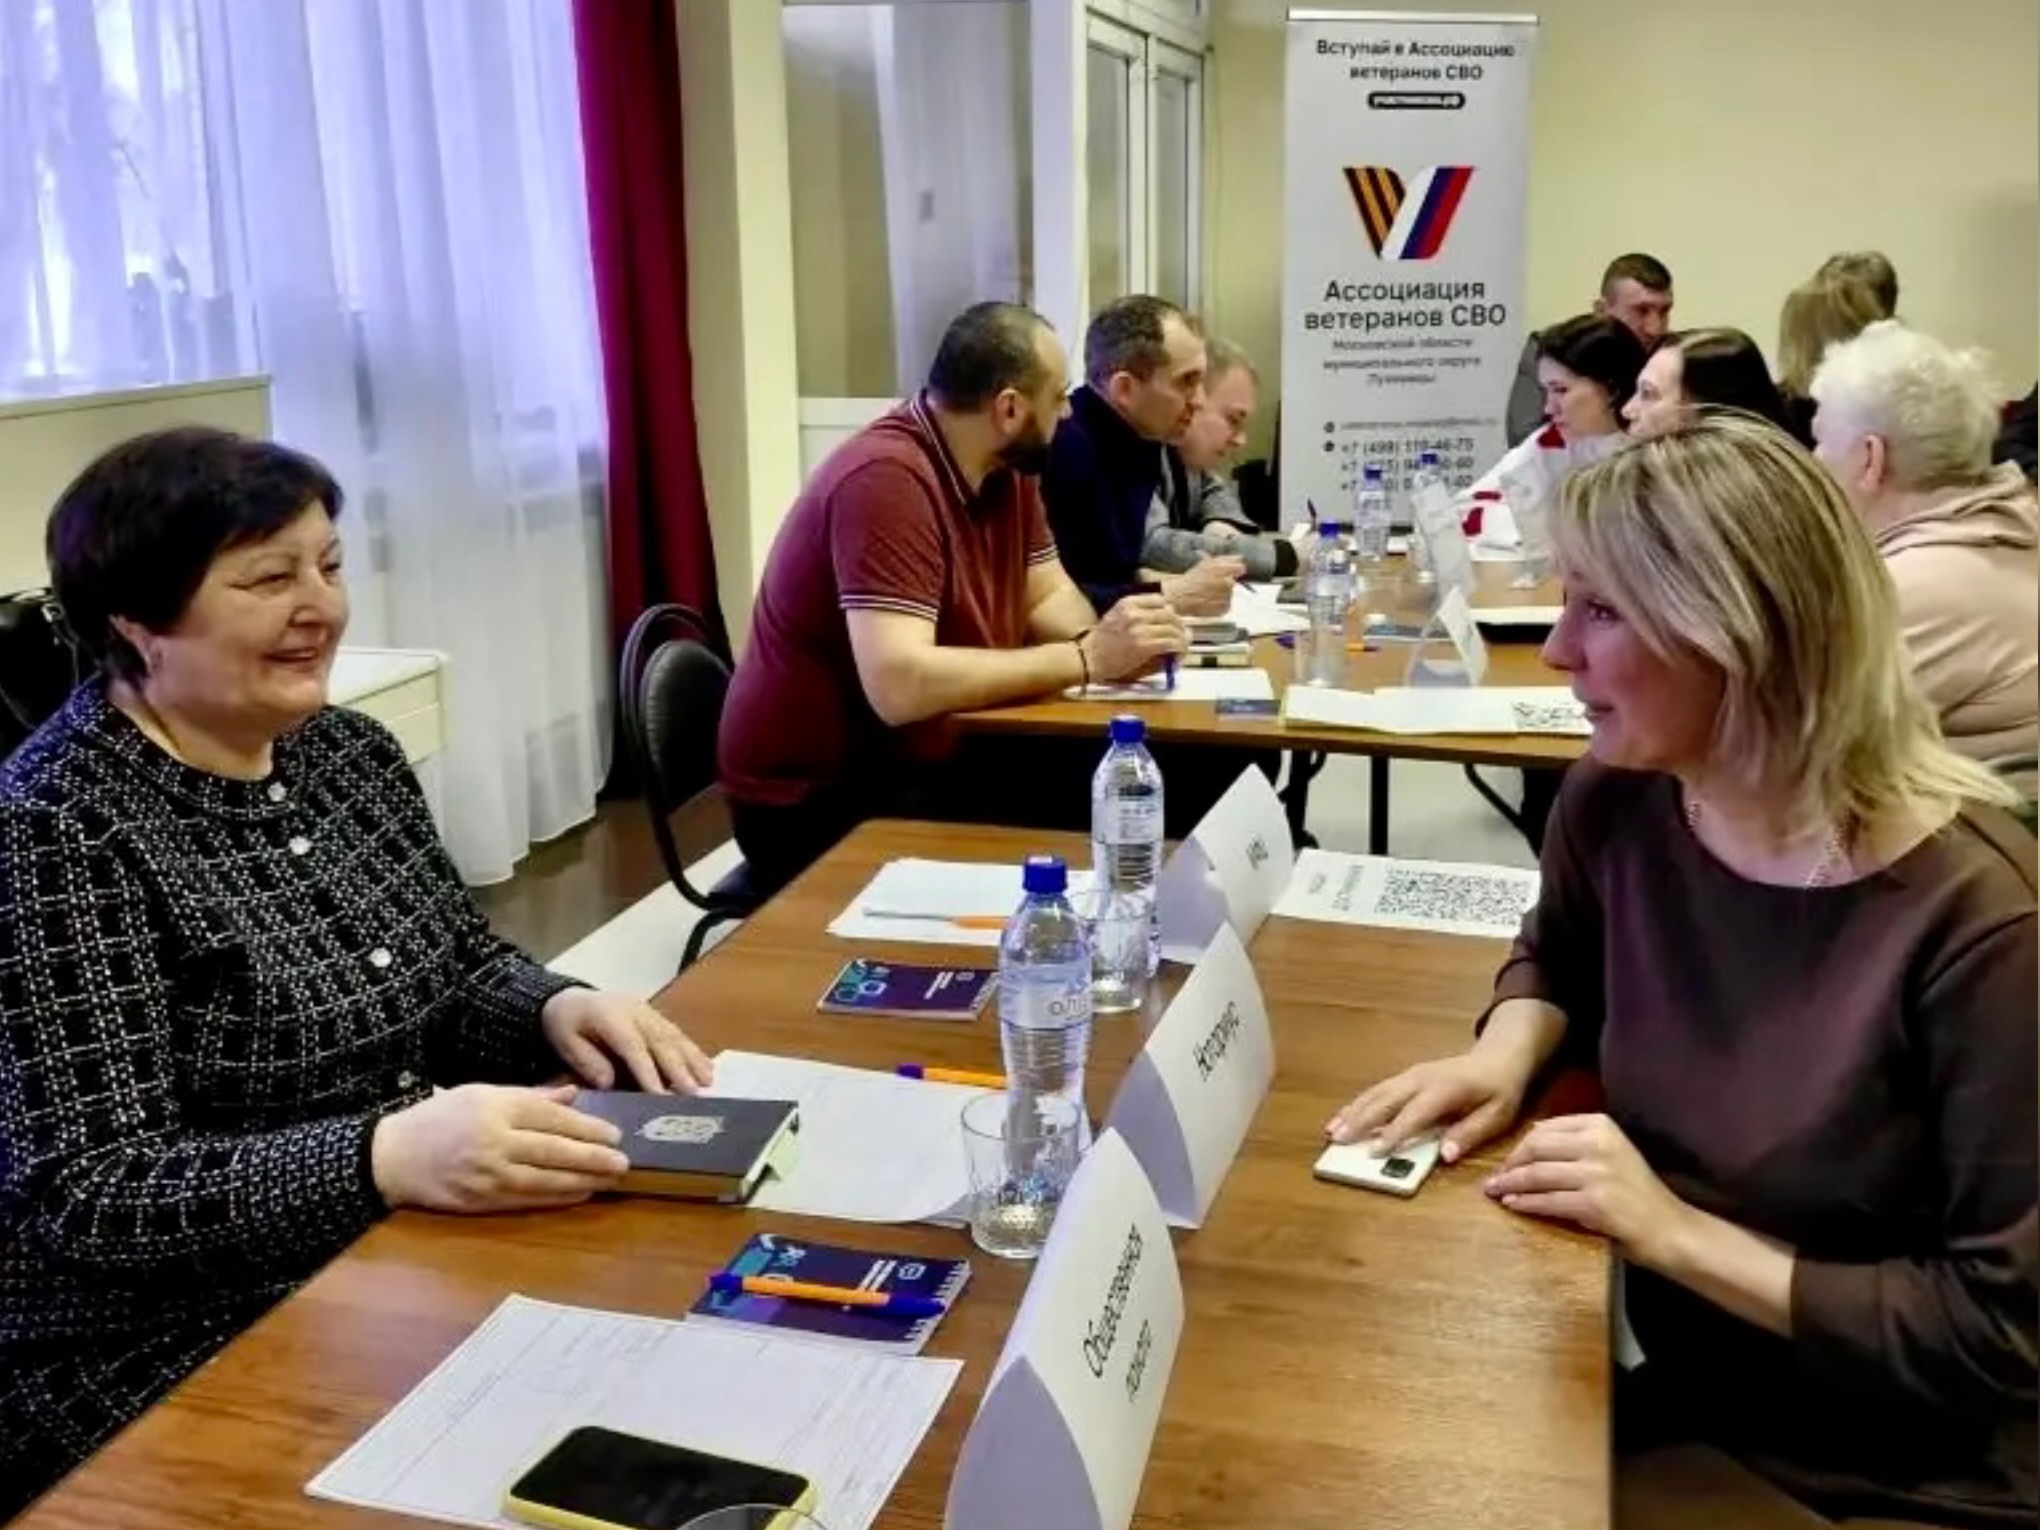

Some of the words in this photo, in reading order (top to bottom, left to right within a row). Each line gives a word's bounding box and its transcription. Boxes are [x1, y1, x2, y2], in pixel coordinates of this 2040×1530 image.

[1316, 39, 1390, 58] Вступай
[1409, 42, 1515, 57] Ассоциацию
[1350, 67, 1442, 82] ветеранов
[1446, 65, 1483, 80] СВО
[1324, 280, 1485, 302] Ассоциация
[1305, 311, 1443, 331] ветеранов
[1451, 304, 1506, 326] СВО
